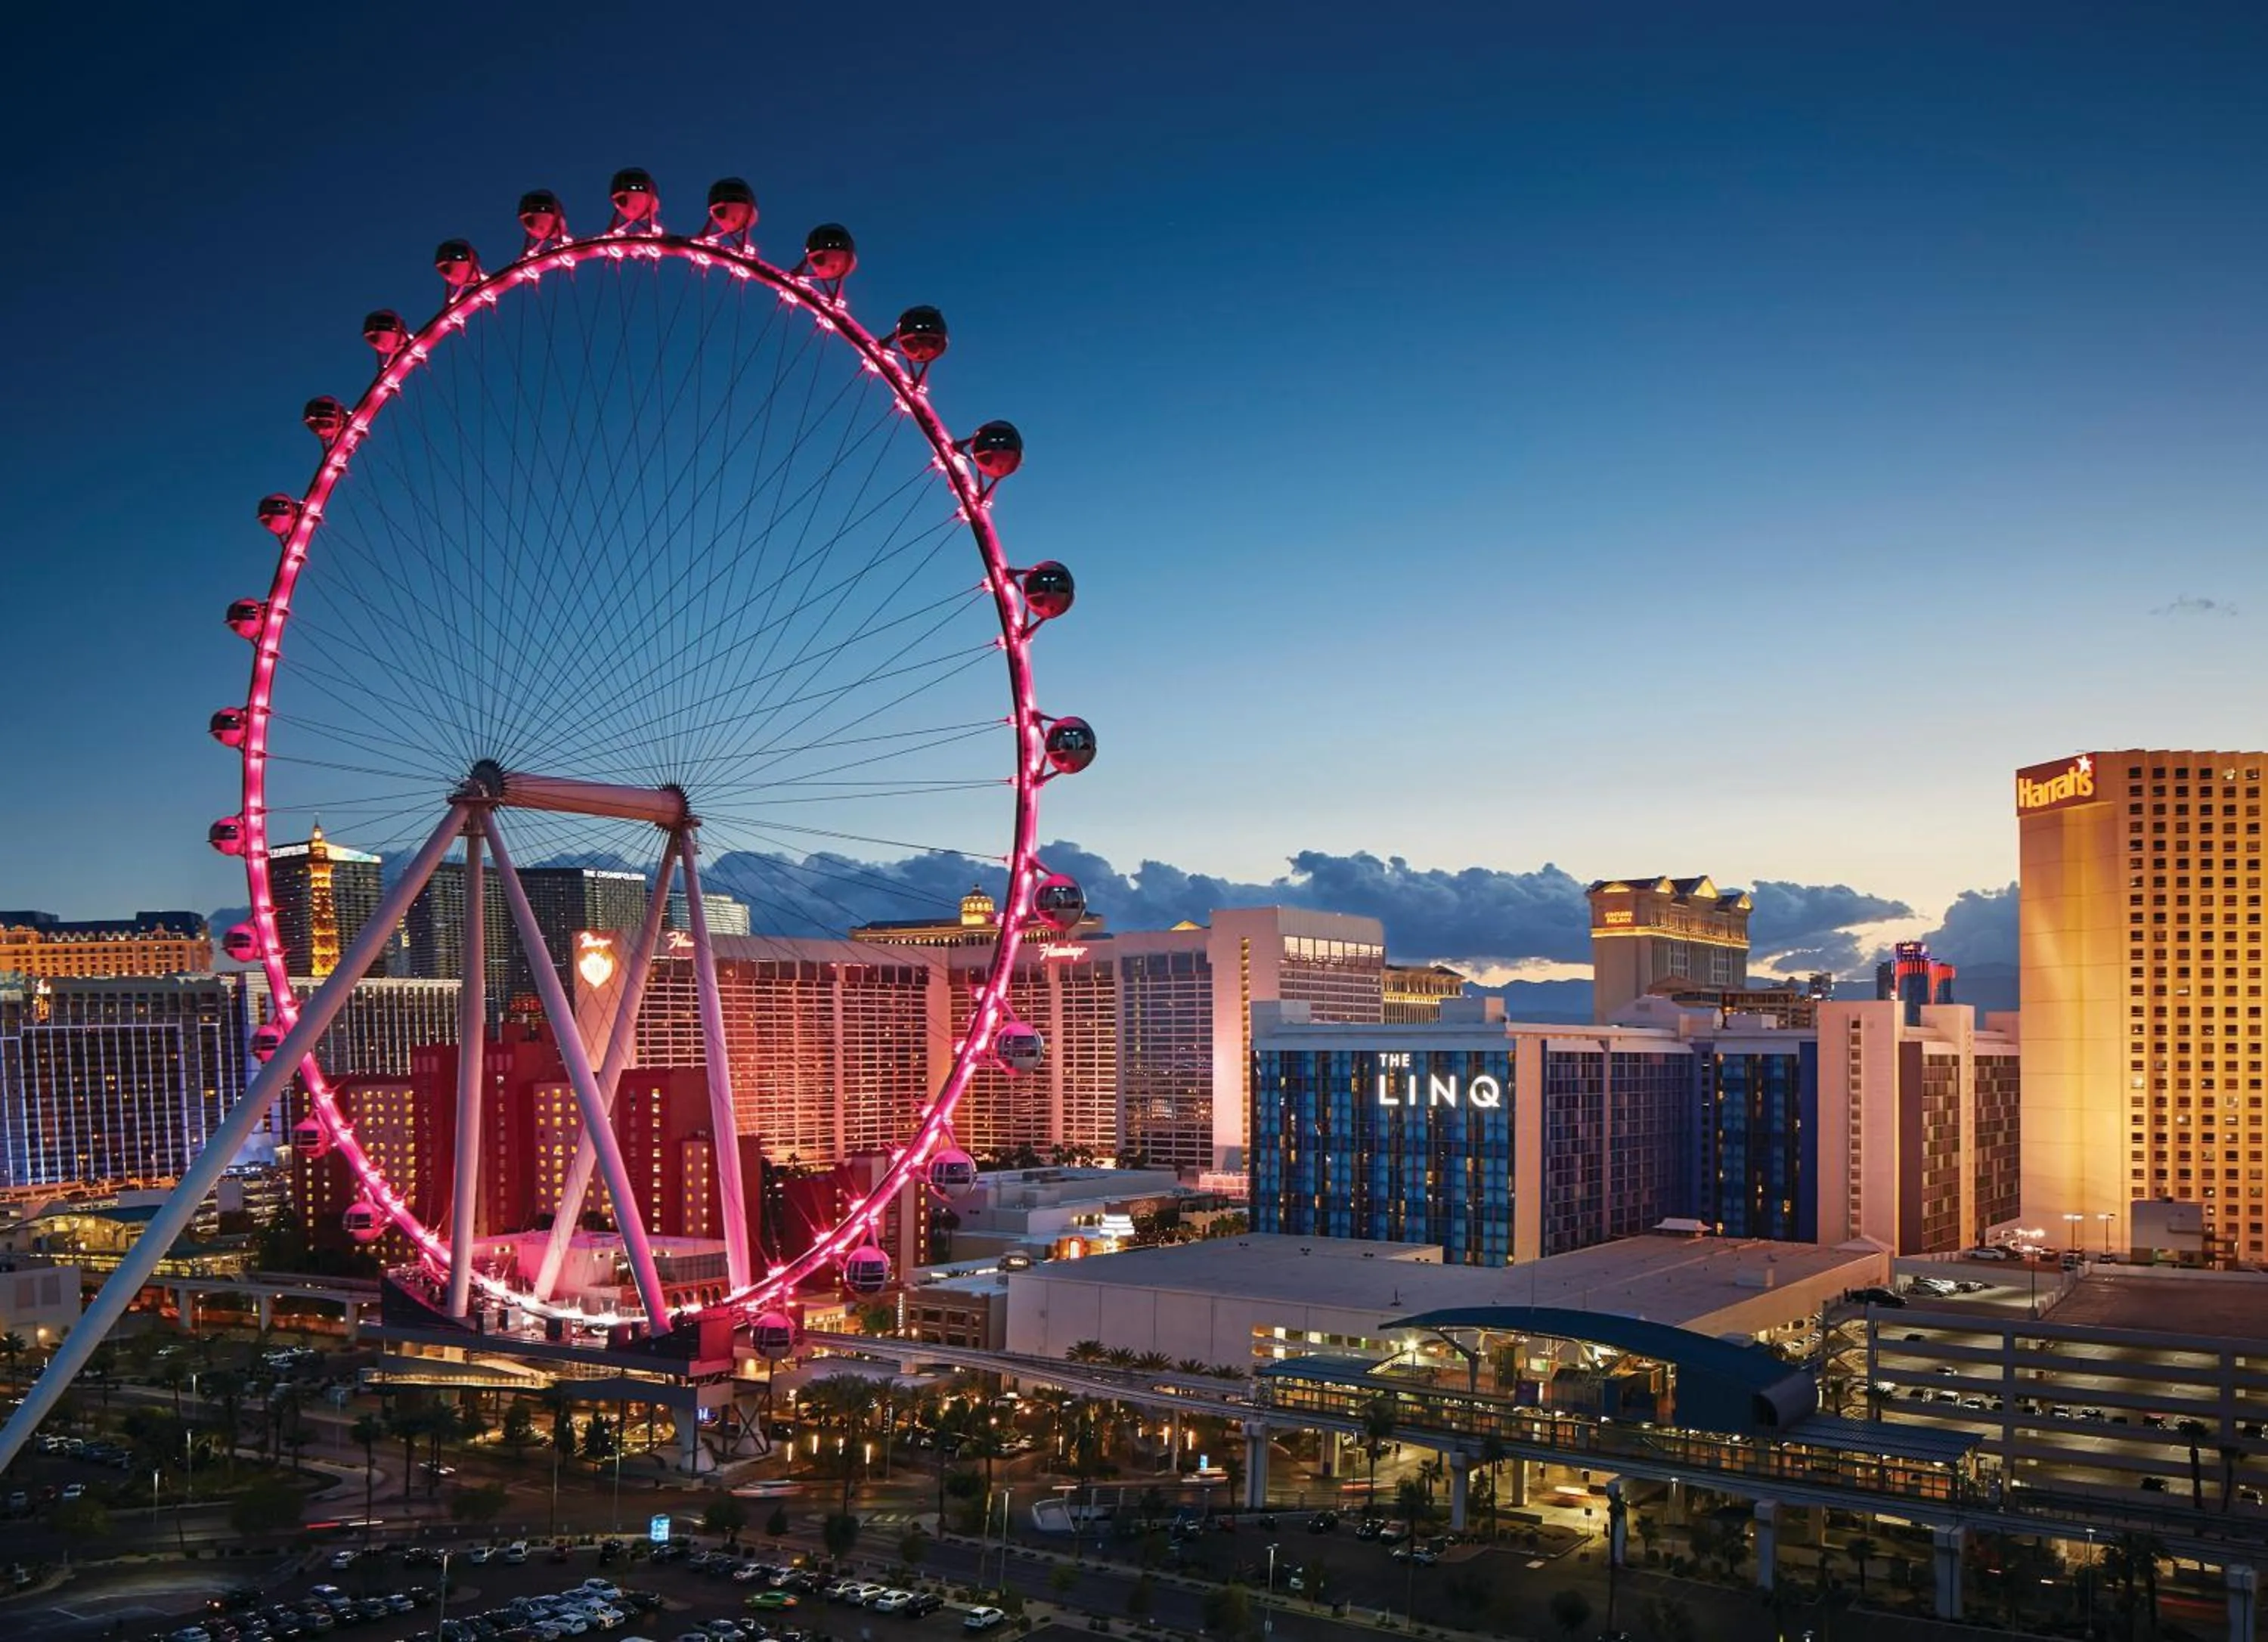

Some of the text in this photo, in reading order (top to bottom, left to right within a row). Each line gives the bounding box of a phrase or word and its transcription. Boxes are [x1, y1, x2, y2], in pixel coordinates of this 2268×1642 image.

[1038, 943, 1088, 962] Flamingo
[1379, 1053, 1410, 1067] THE
[1379, 1073, 1501, 1108] LINQ
